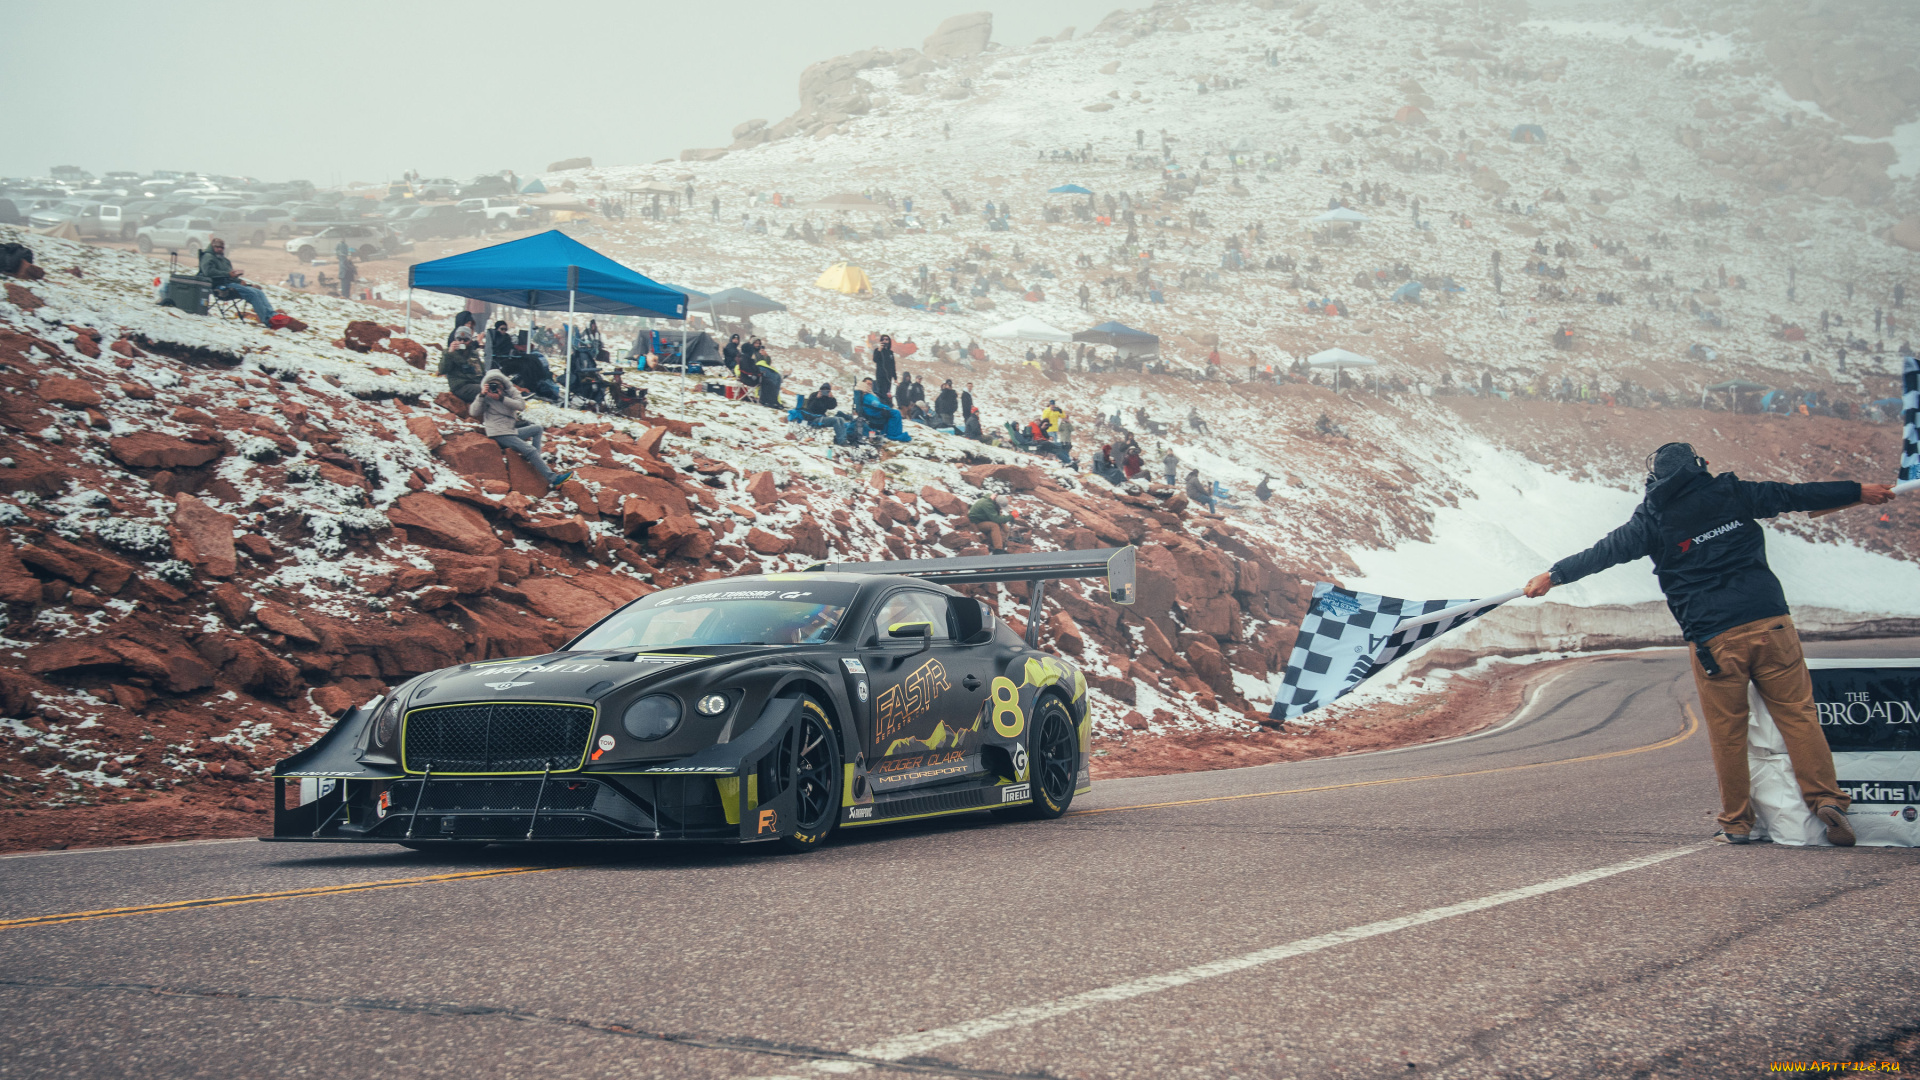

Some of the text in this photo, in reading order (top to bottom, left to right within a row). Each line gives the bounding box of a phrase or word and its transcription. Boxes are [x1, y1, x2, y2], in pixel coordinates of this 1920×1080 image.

[876, 657, 951, 737] FASTR
[991, 676, 1025, 738] 8
[1844, 691, 1870, 702] THE
[875, 702, 930, 745] BEFASTR.COM
[879, 756, 924, 774] ROGER
[1016, 750, 1026, 771] G
[879, 765, 968, 783] MOTORSPORT
[1001, 782, 1030, 803] PIRELLI
[1838, 782, 1904, 801] erkins
